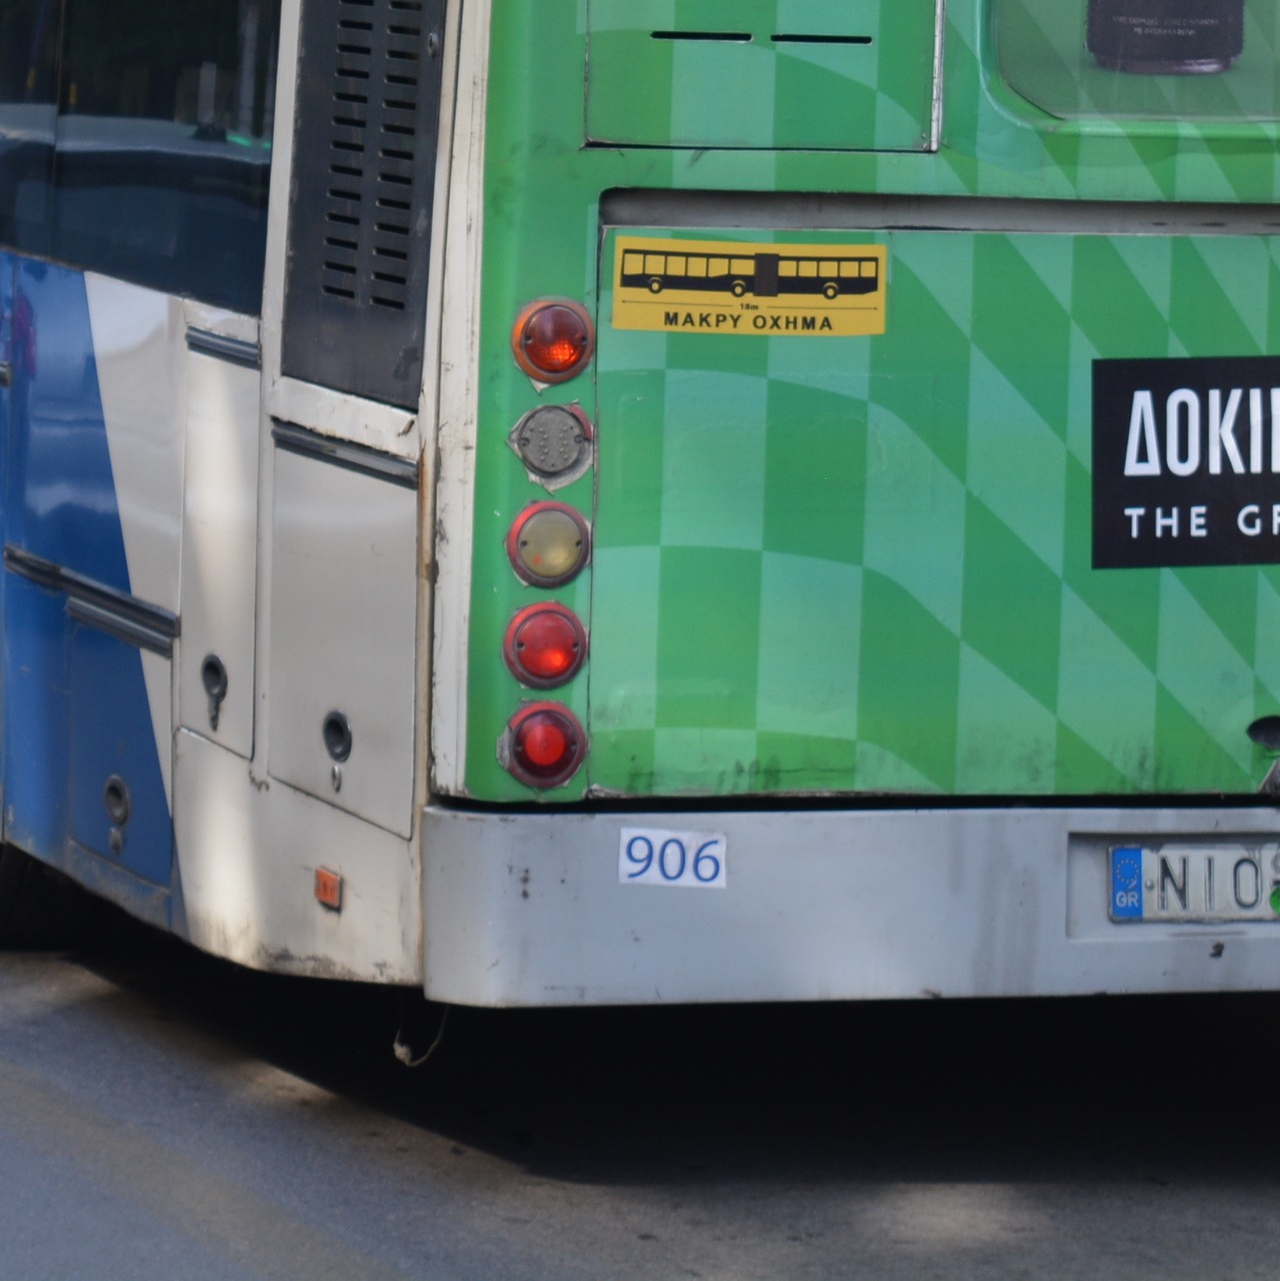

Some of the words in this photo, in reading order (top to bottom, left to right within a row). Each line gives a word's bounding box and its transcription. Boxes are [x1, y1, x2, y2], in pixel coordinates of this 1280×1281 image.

[664, 311, 742, 329] ΜΑΚΡΥ
[752, 314, 833, 331] ΟΧΗΜΑ
[1124, 506, 1208, 539] THE
[626, 836, 720, 883] 906
[1115, 891, 1140, 909] GR
